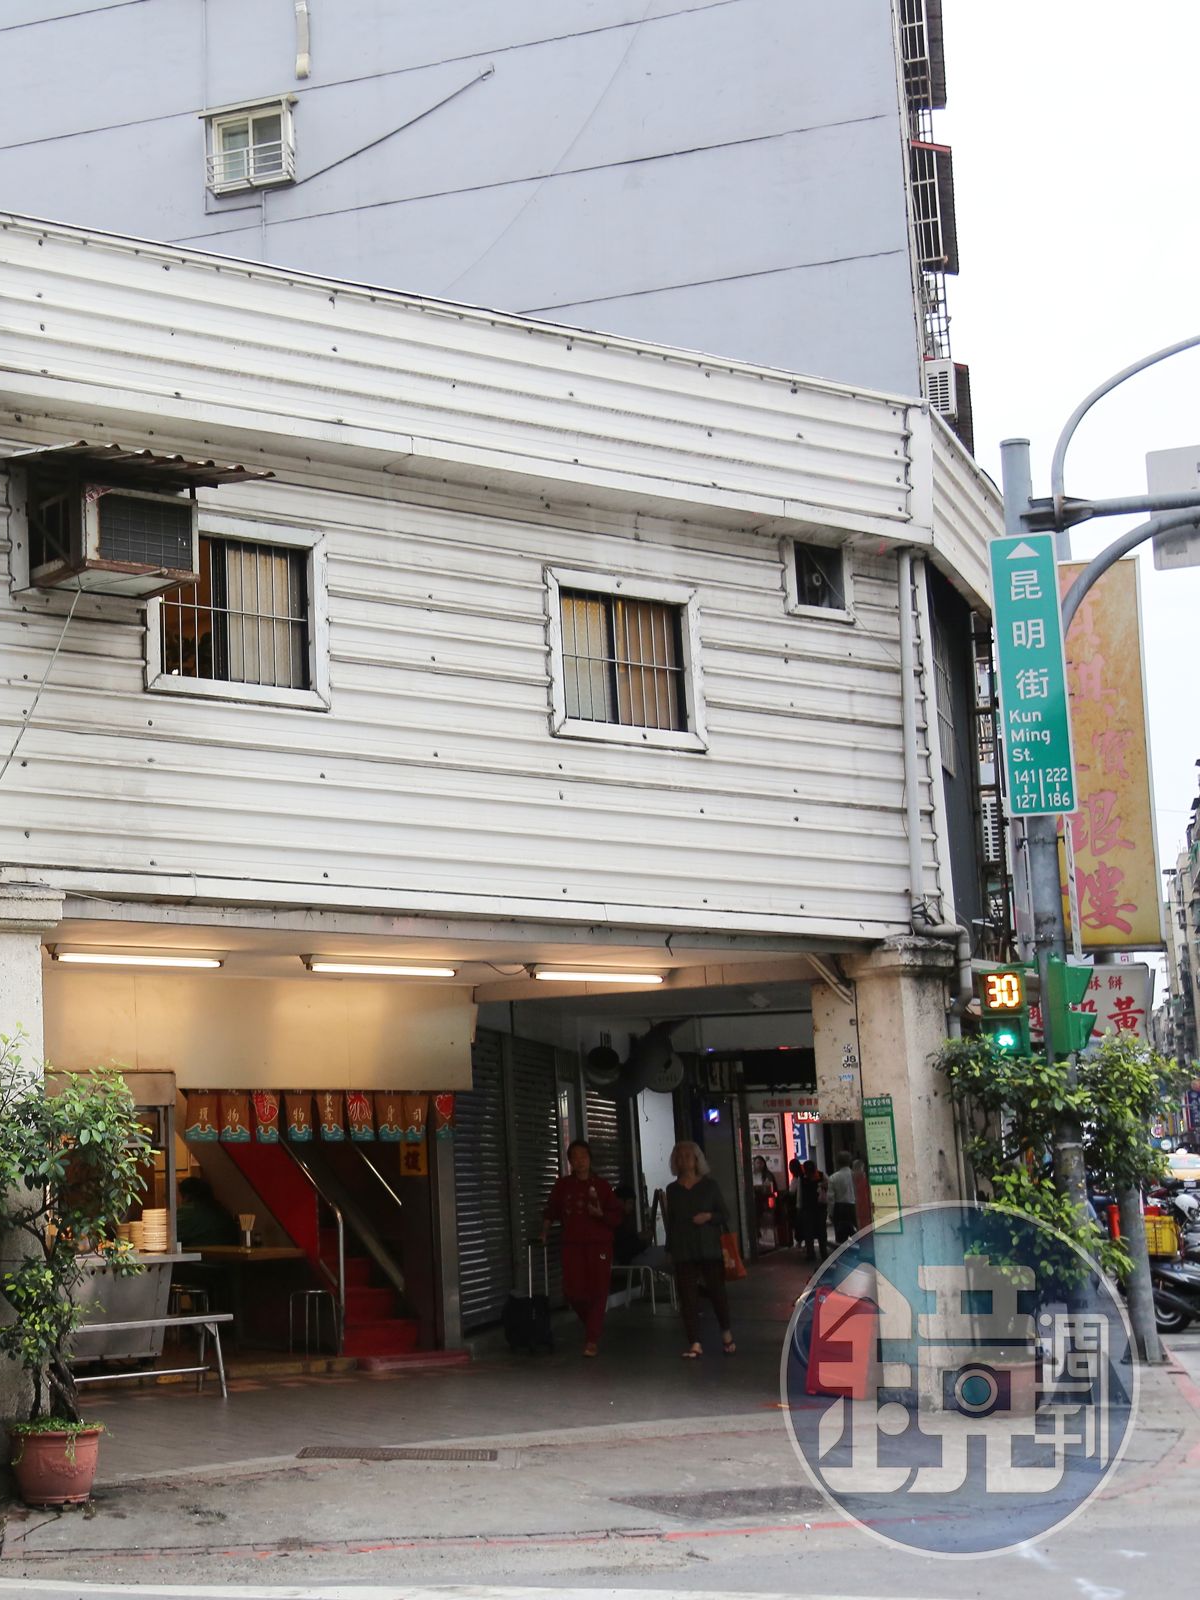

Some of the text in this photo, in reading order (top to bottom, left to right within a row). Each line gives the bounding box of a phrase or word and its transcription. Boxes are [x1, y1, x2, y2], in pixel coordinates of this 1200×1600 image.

[1010, 569, 1048, 700] 昆明街
[1009, 709, 1042, 723] Kun
[1011, 728, 1051, 745] Ming
[1012, 748, 1034, 762] St.
[1014, 767, 1068, 784] 141 222
[1016, 792, 1070, 809] 127 186
[986, 975, 1019, 1008] 30
